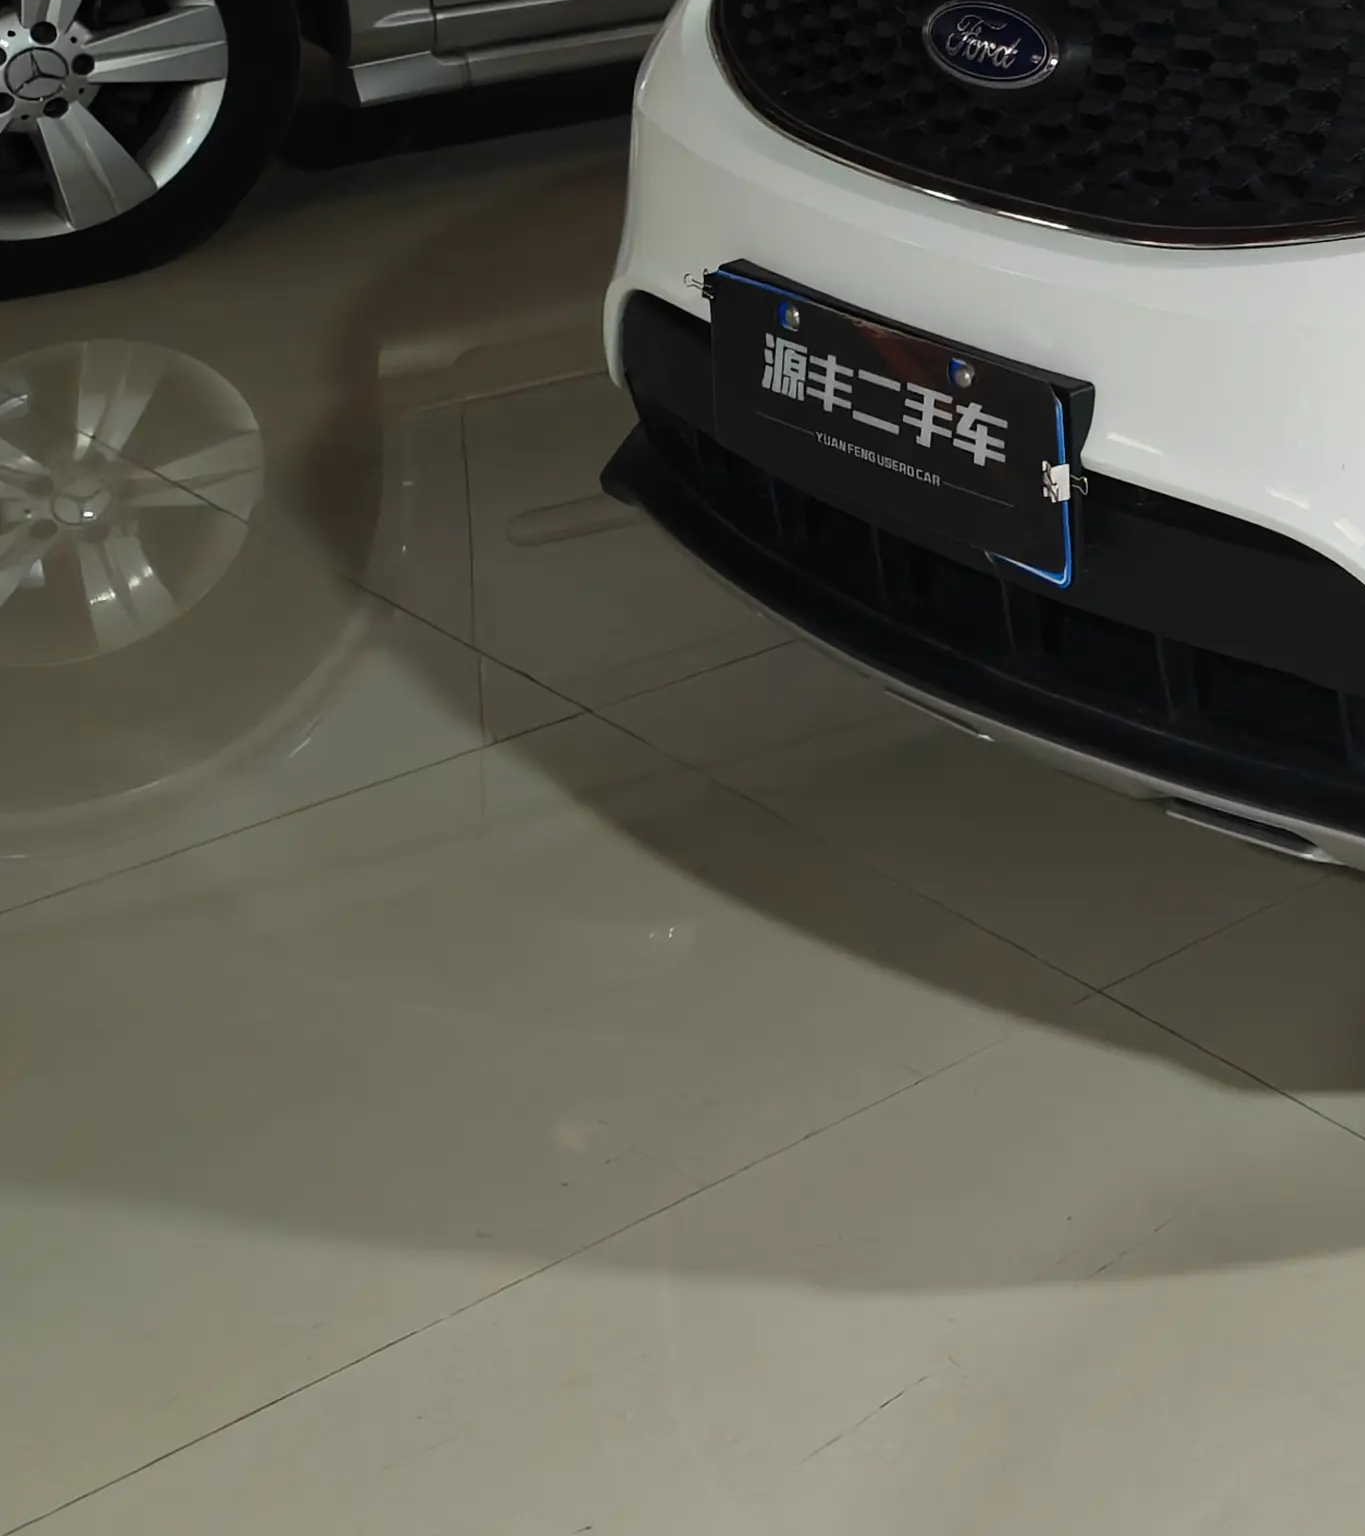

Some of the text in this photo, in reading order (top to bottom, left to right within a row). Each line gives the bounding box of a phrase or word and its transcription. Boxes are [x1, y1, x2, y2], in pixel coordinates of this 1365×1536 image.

[946, 14, 1022, 68] Ford
[762, 333, 1008, 466] 源丰二手车
